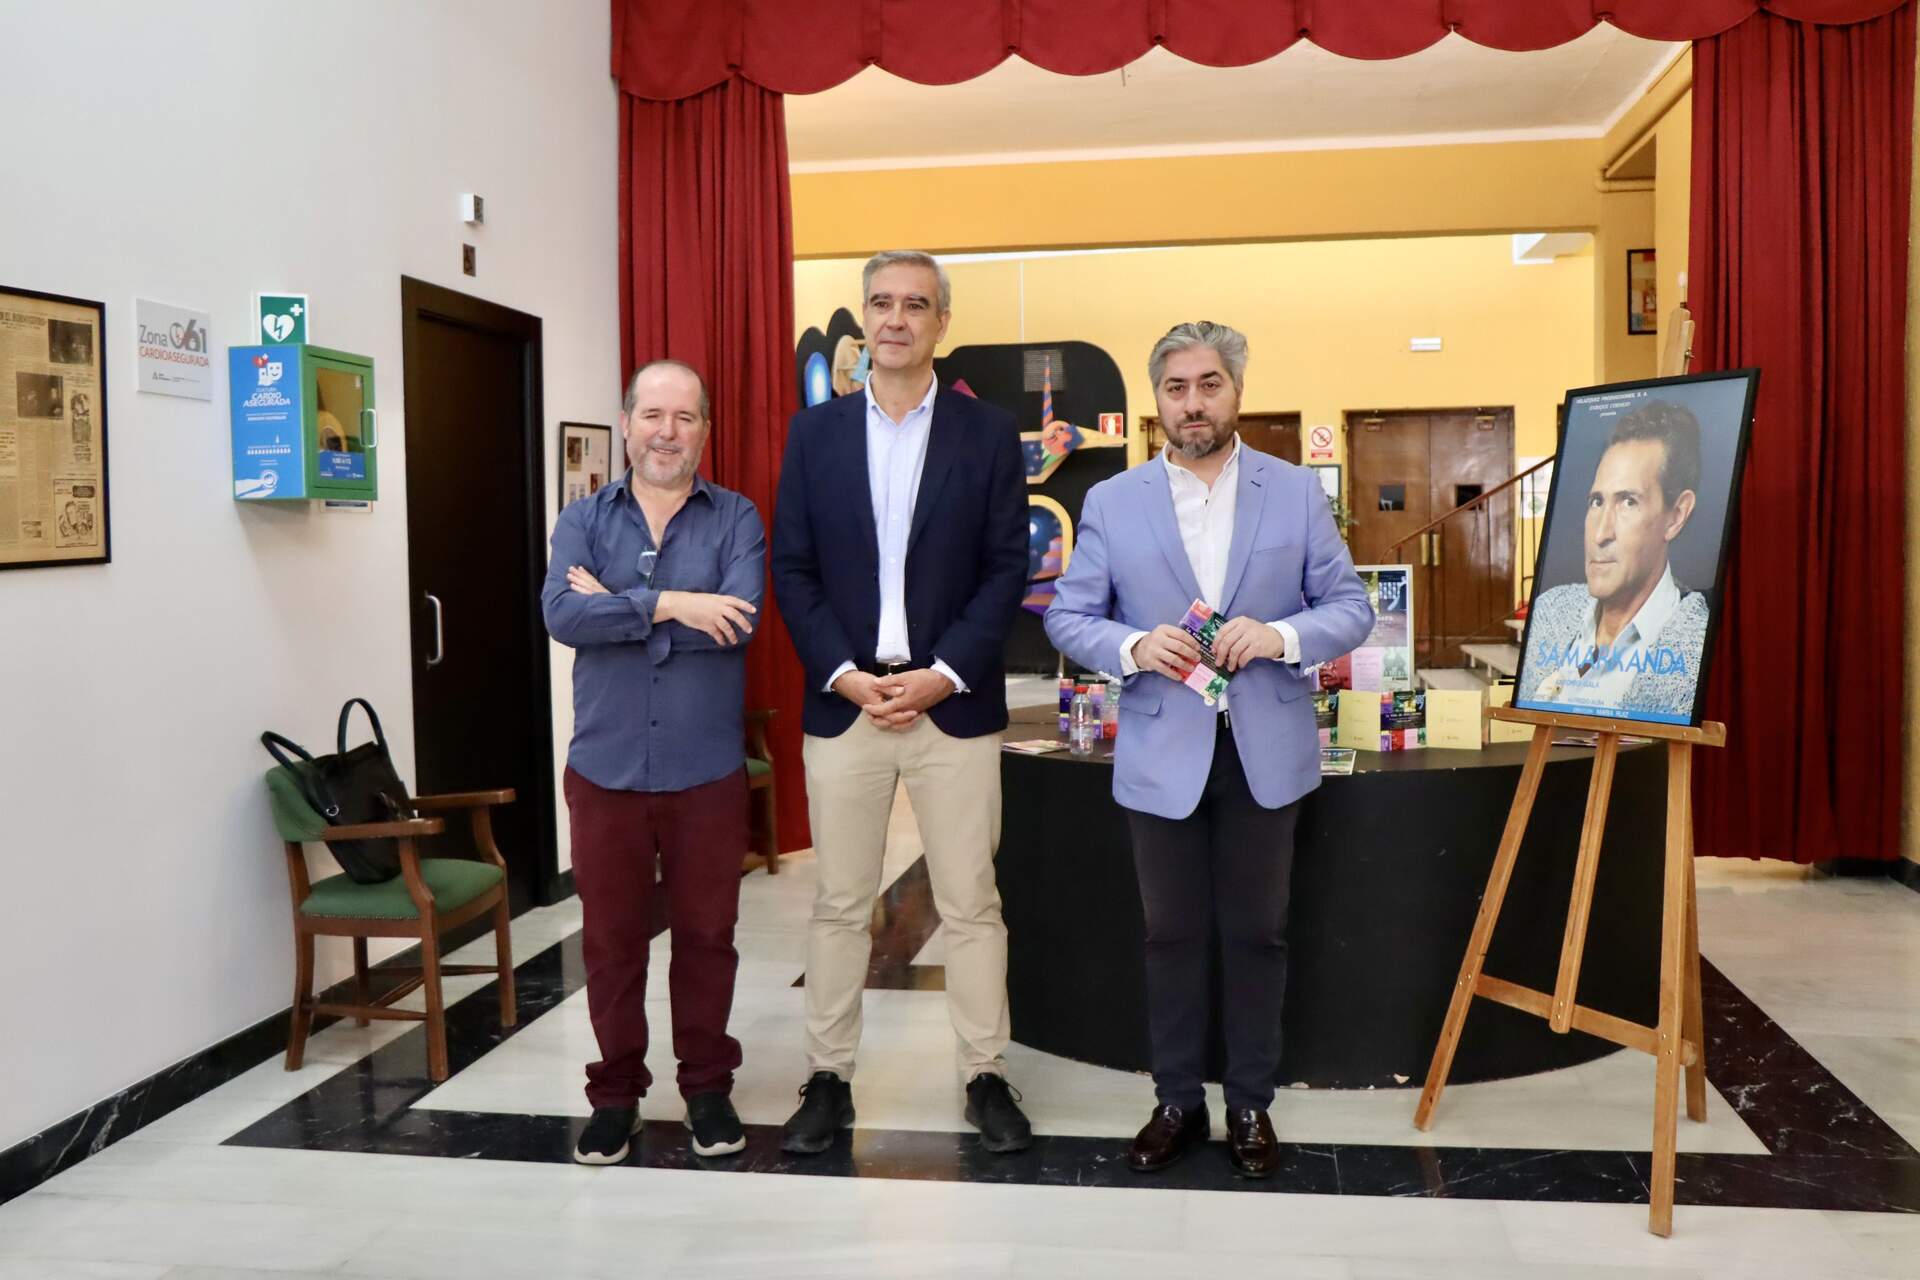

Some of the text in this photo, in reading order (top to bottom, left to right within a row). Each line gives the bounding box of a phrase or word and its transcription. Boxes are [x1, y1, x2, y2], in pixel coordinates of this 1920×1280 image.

[139, 324, 168, 347] Zona
[139, 346, 209, 368] CARDIOASEGURADA
[242, 398, 291, 408] ASEGURADA
[251, 391, 282, 401] CARDIO
[1535, 640, 1687, 677] SAMARKANDA
